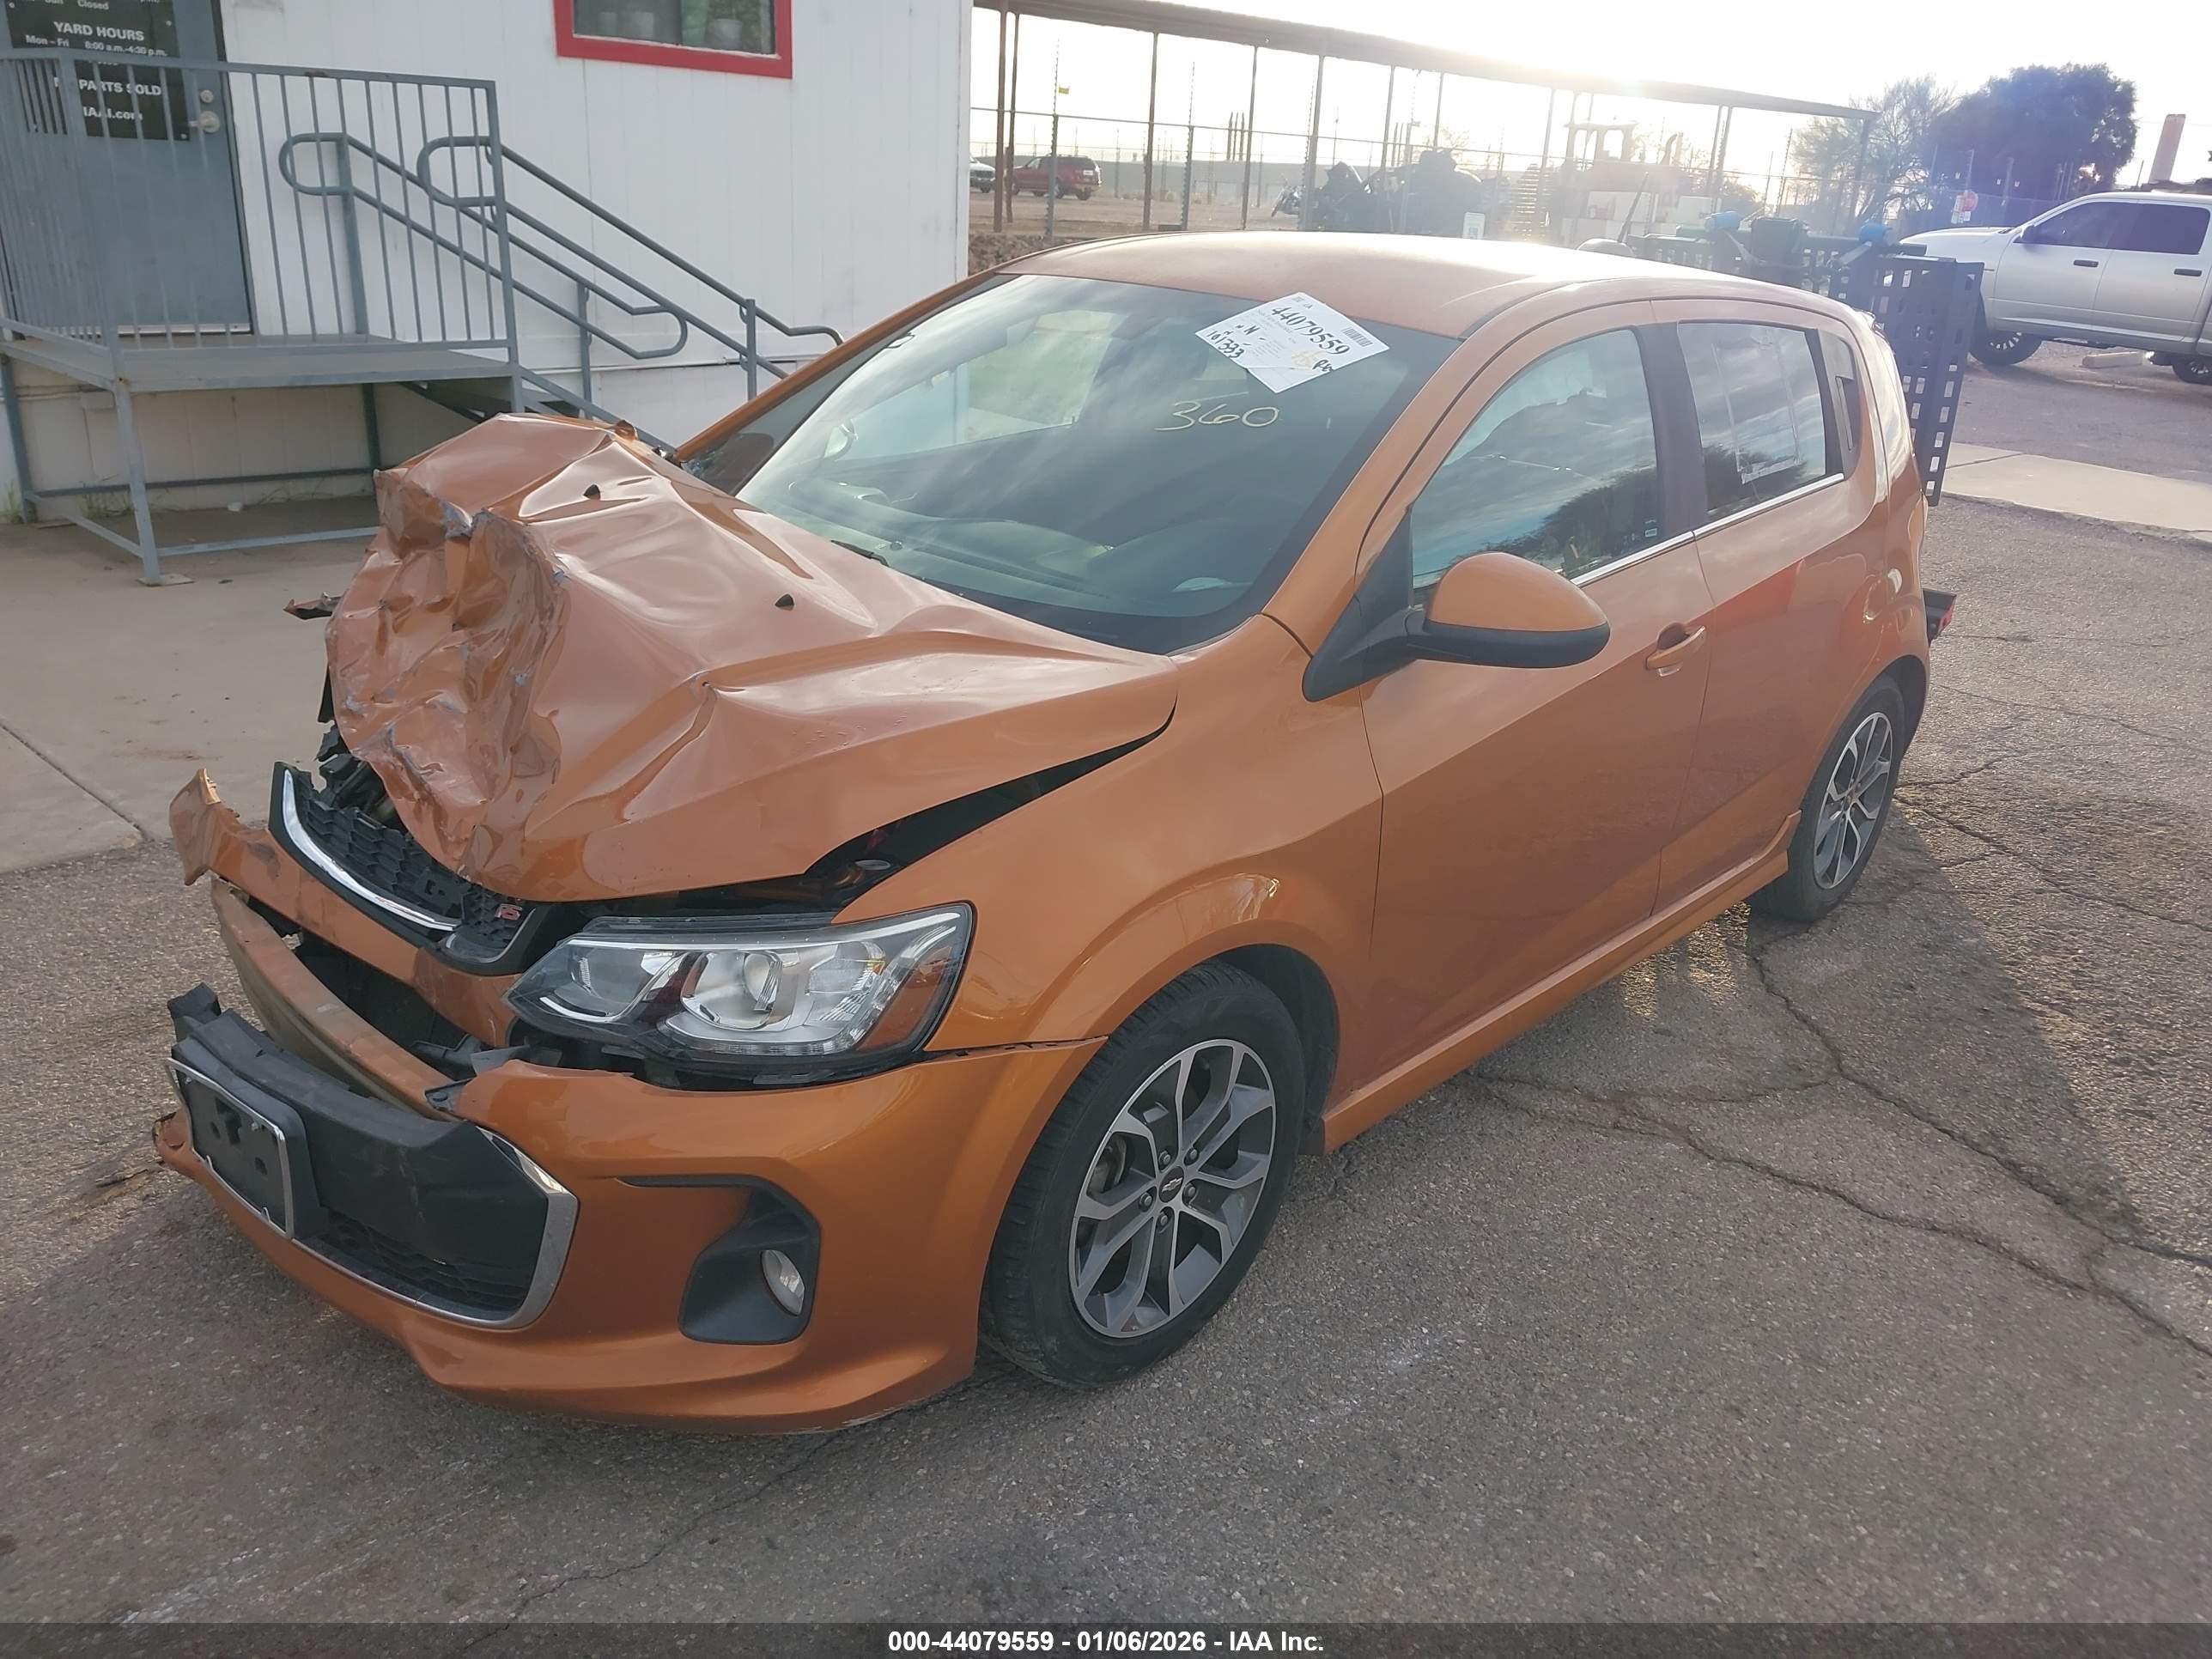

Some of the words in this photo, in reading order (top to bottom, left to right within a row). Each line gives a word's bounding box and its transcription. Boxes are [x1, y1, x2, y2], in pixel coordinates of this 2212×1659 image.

[77, 0, 109, 10] Closed
[53, 21, 93, 35] YARD
[96, 27, 145, 41] HOURS
[25, 35, 48, 46] Mon
[58, 38, 70, 46] Fri
[82, 106, 143, 120] IAI.com
[1271, 307, 1352, 355] 44079559
[1153, 398, 1279, 430] 360
